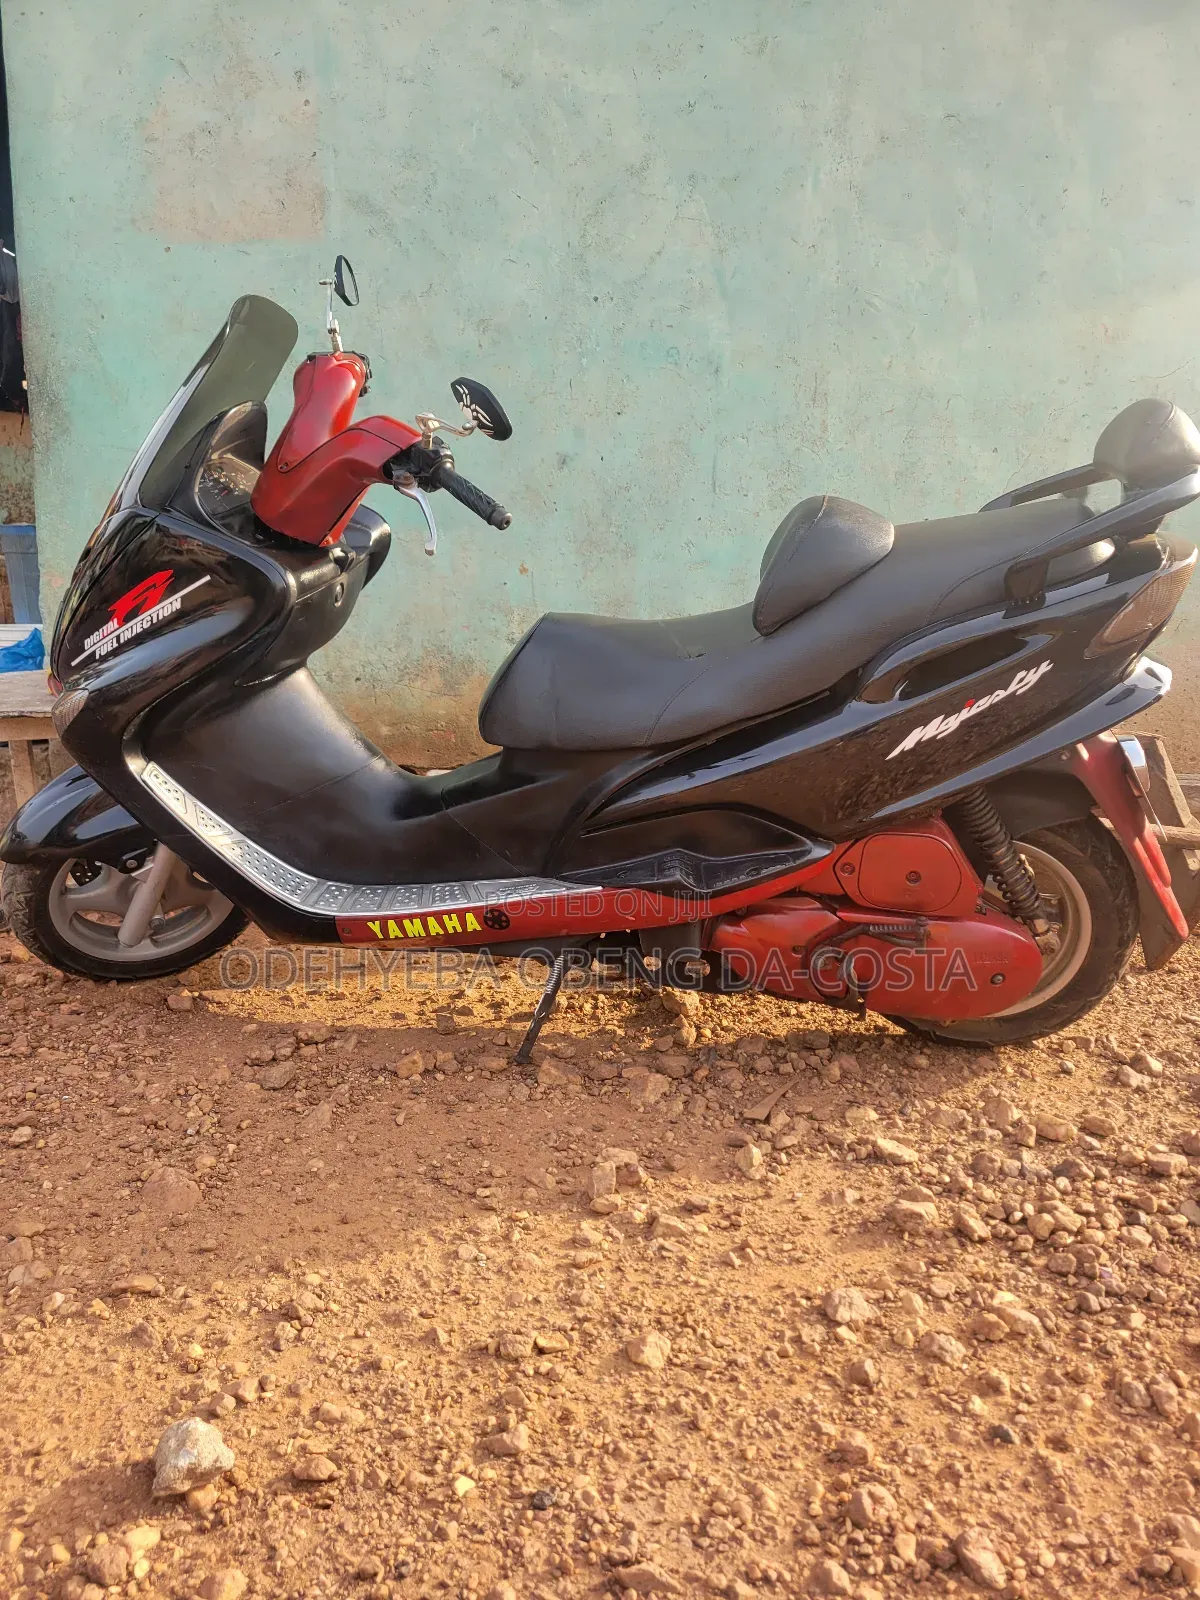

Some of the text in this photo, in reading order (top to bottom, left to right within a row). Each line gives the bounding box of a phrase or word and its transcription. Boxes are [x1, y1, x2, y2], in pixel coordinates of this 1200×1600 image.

[84, 618, 119, 650] DIGITAL
[95, 597, 182, 659] FUEL INJECTION
[367, 912, 482, 940] YAMAHA
